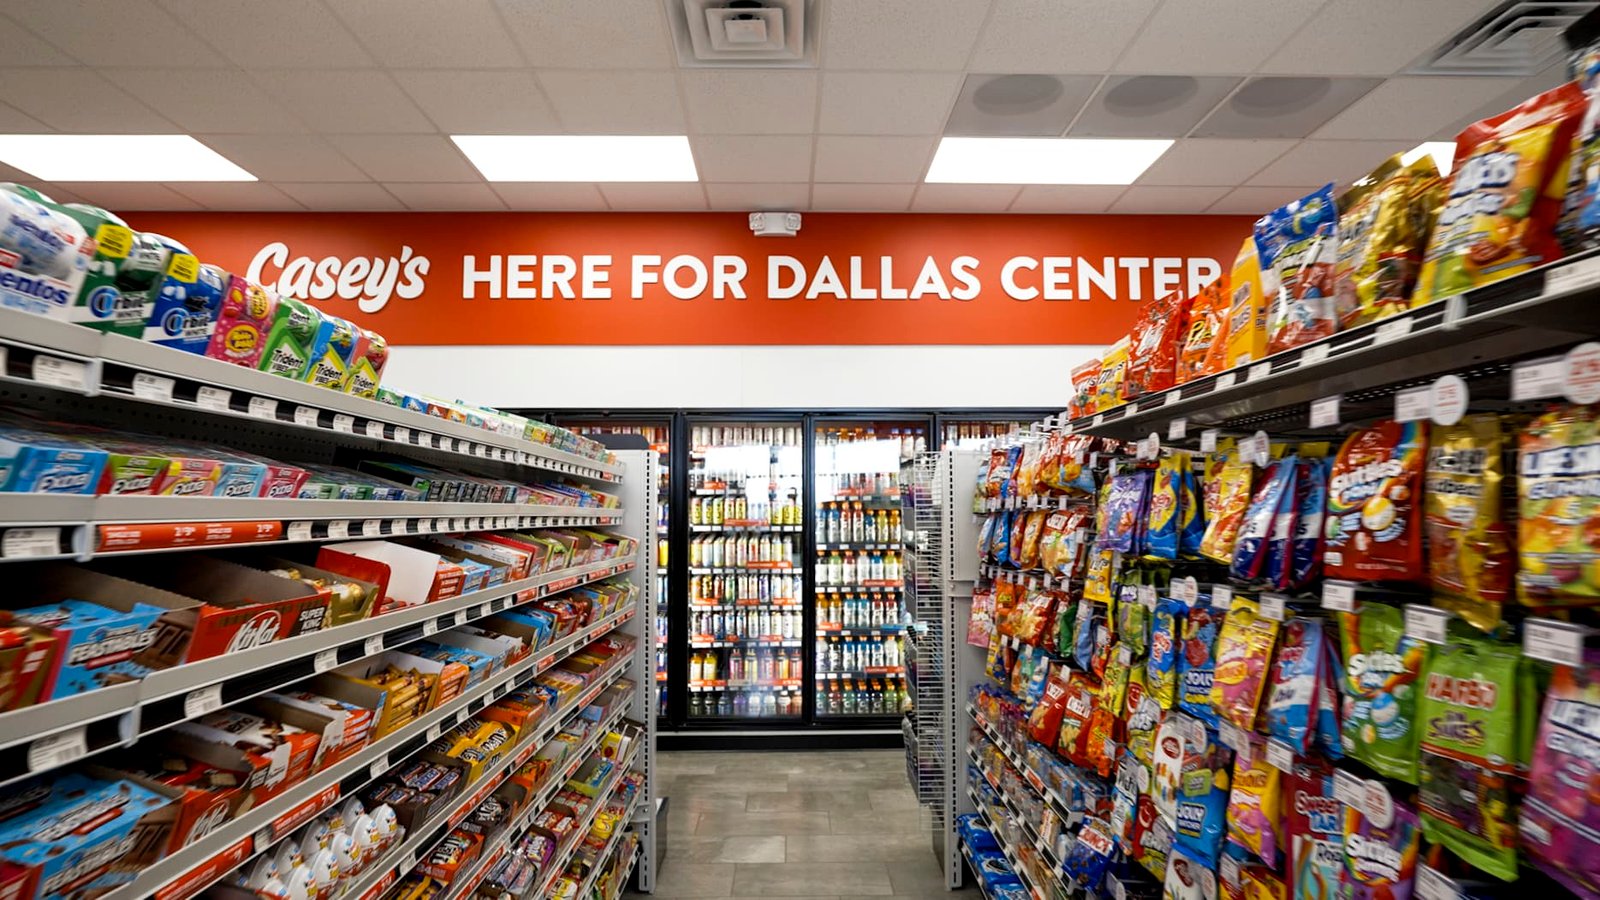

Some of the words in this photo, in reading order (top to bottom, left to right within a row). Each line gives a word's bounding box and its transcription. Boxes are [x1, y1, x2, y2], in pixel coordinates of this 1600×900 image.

[0, 271, 70, 305] entos
[246, 242, 431, 314] Casey's
[464, 255, 612, 298] HERE
[632, 255, 746, 299] FOR
[768, 256, 980, 300] DALLAS
[1000, 256, 1222, 301] CENTER
[271, 349, 304, 369] Trident
[316, 363, 343, 380] Trident
[300, 606, 325, 622] SUPER
[301, 619, 324, 633] KING
